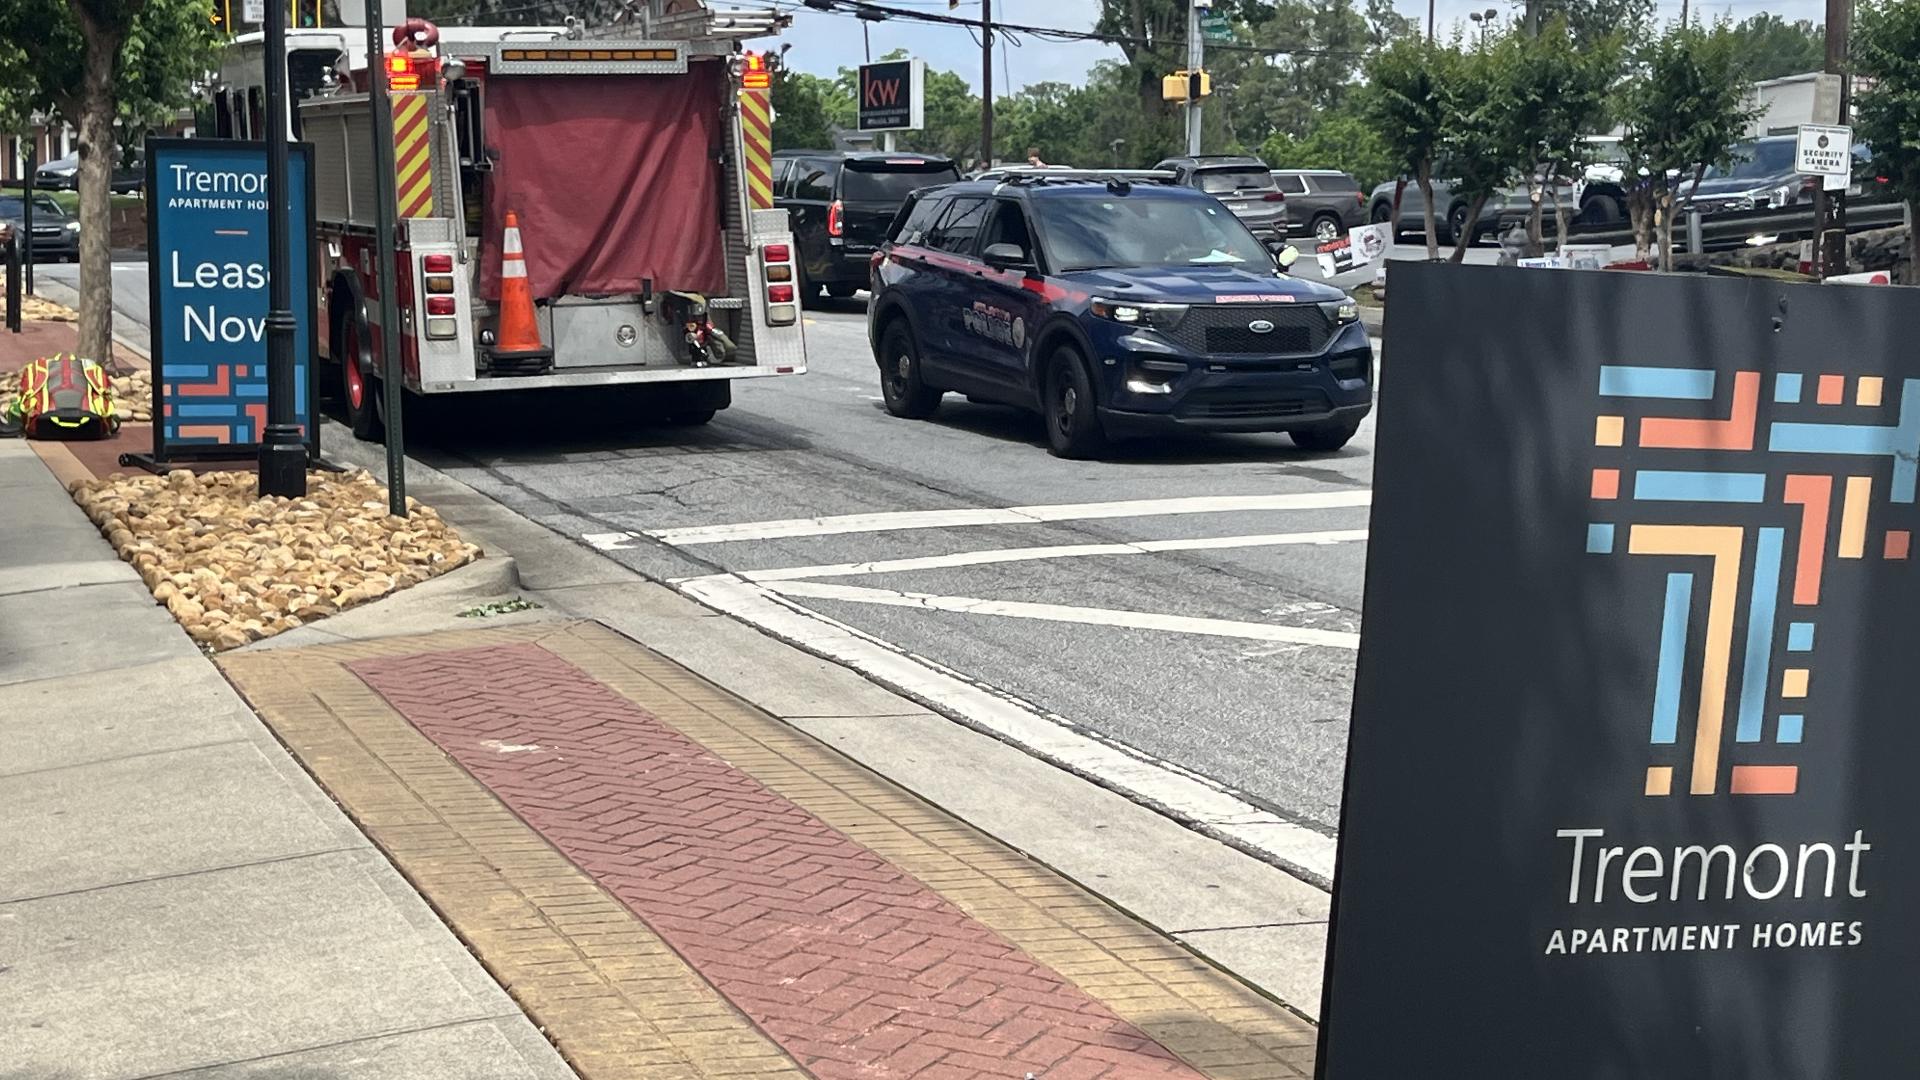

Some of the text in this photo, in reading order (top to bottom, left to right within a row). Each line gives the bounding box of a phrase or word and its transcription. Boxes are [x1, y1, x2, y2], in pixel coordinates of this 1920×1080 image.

[1803, 149, 1844, 159] SECURITY
[1805, 158, 1840, 166] CAMERA
[169, 164, 268, 194] Tremo
[168, 198, 243, 210] APARTMENT
[172, 250, 270, 289] Leas
[1556, 828, 1872, 904] Tremont
[1545, 921, 1863, 955] APARTMENT HOMES
